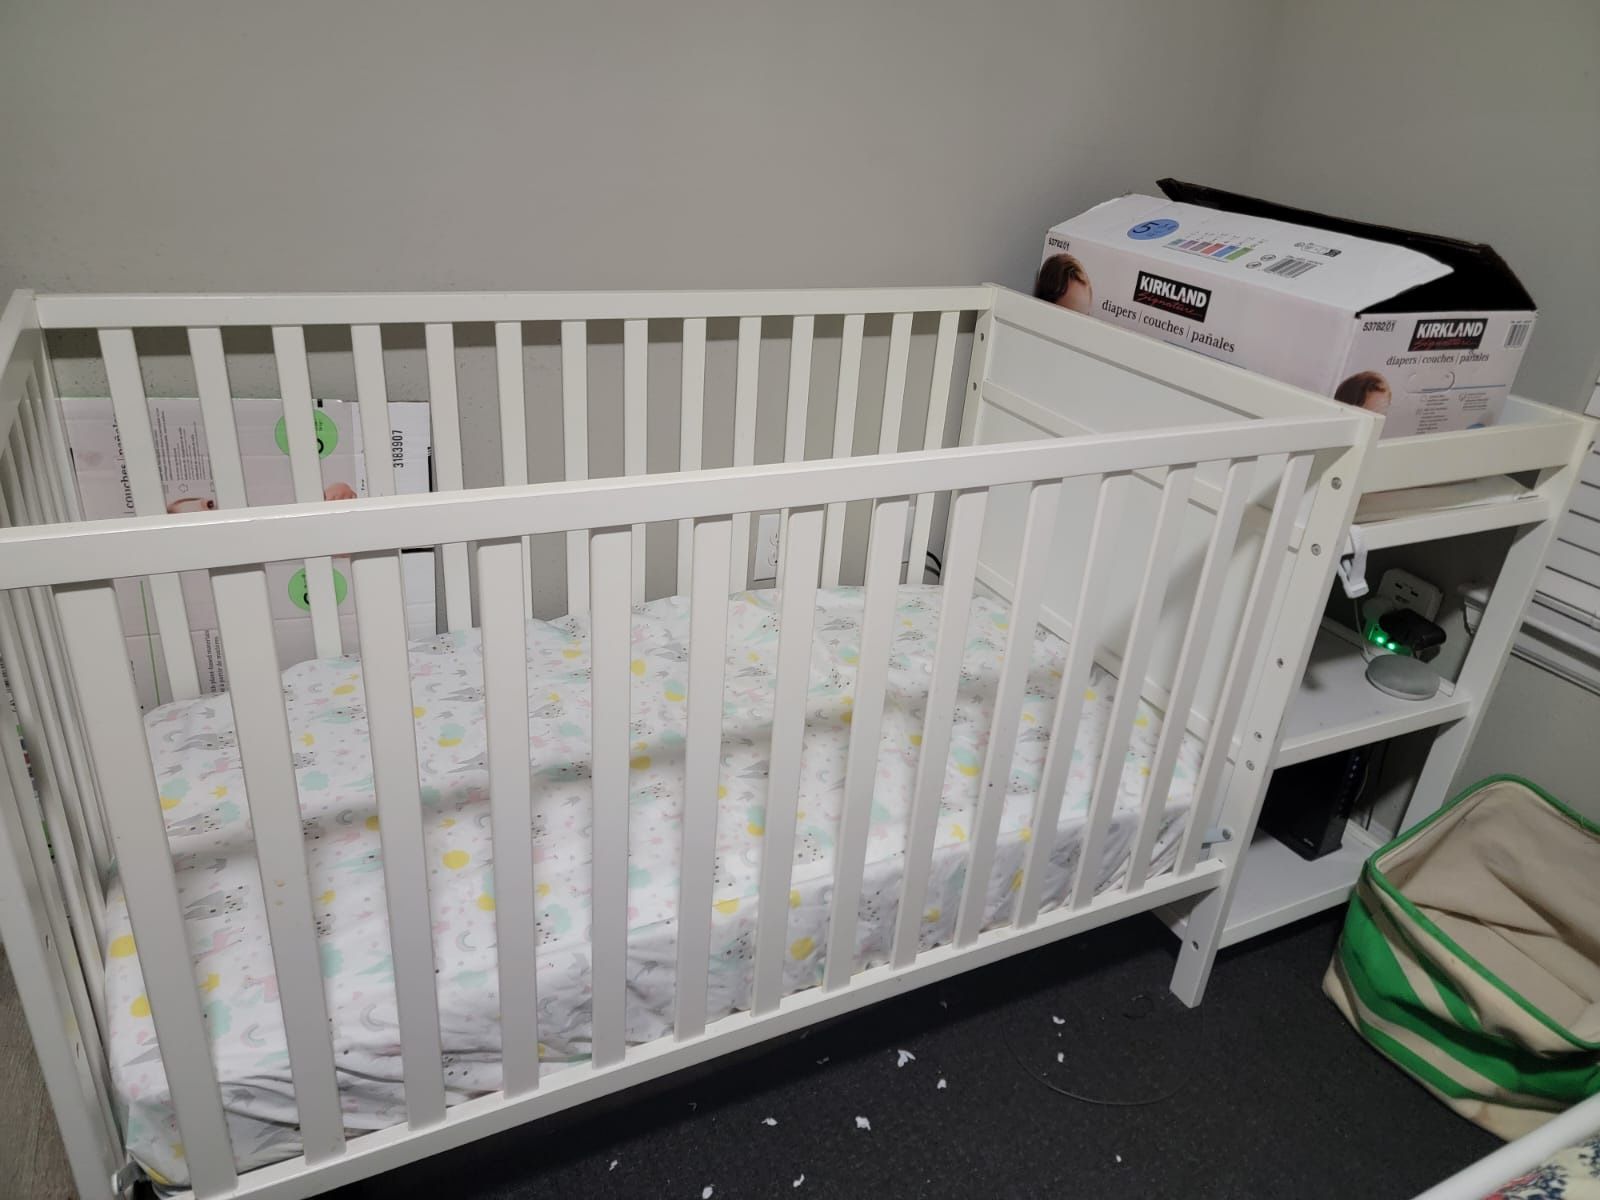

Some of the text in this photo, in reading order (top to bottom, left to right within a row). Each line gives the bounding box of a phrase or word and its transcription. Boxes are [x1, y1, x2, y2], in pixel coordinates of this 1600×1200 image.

[1139, 275, 1207, 308] KIRKLAND
[1101, 300, 1137, 320] diapers
[1143, 313, 1185, 337] couches
[1191, 330, 1236, 353] pañales
[1416, 321, 1484, 339] KIRKLAND
[1386, 355, 1417, 367] diapers
[1422, 353, 1454, 364] couches
[391, 429, 404, 469] 3183907
